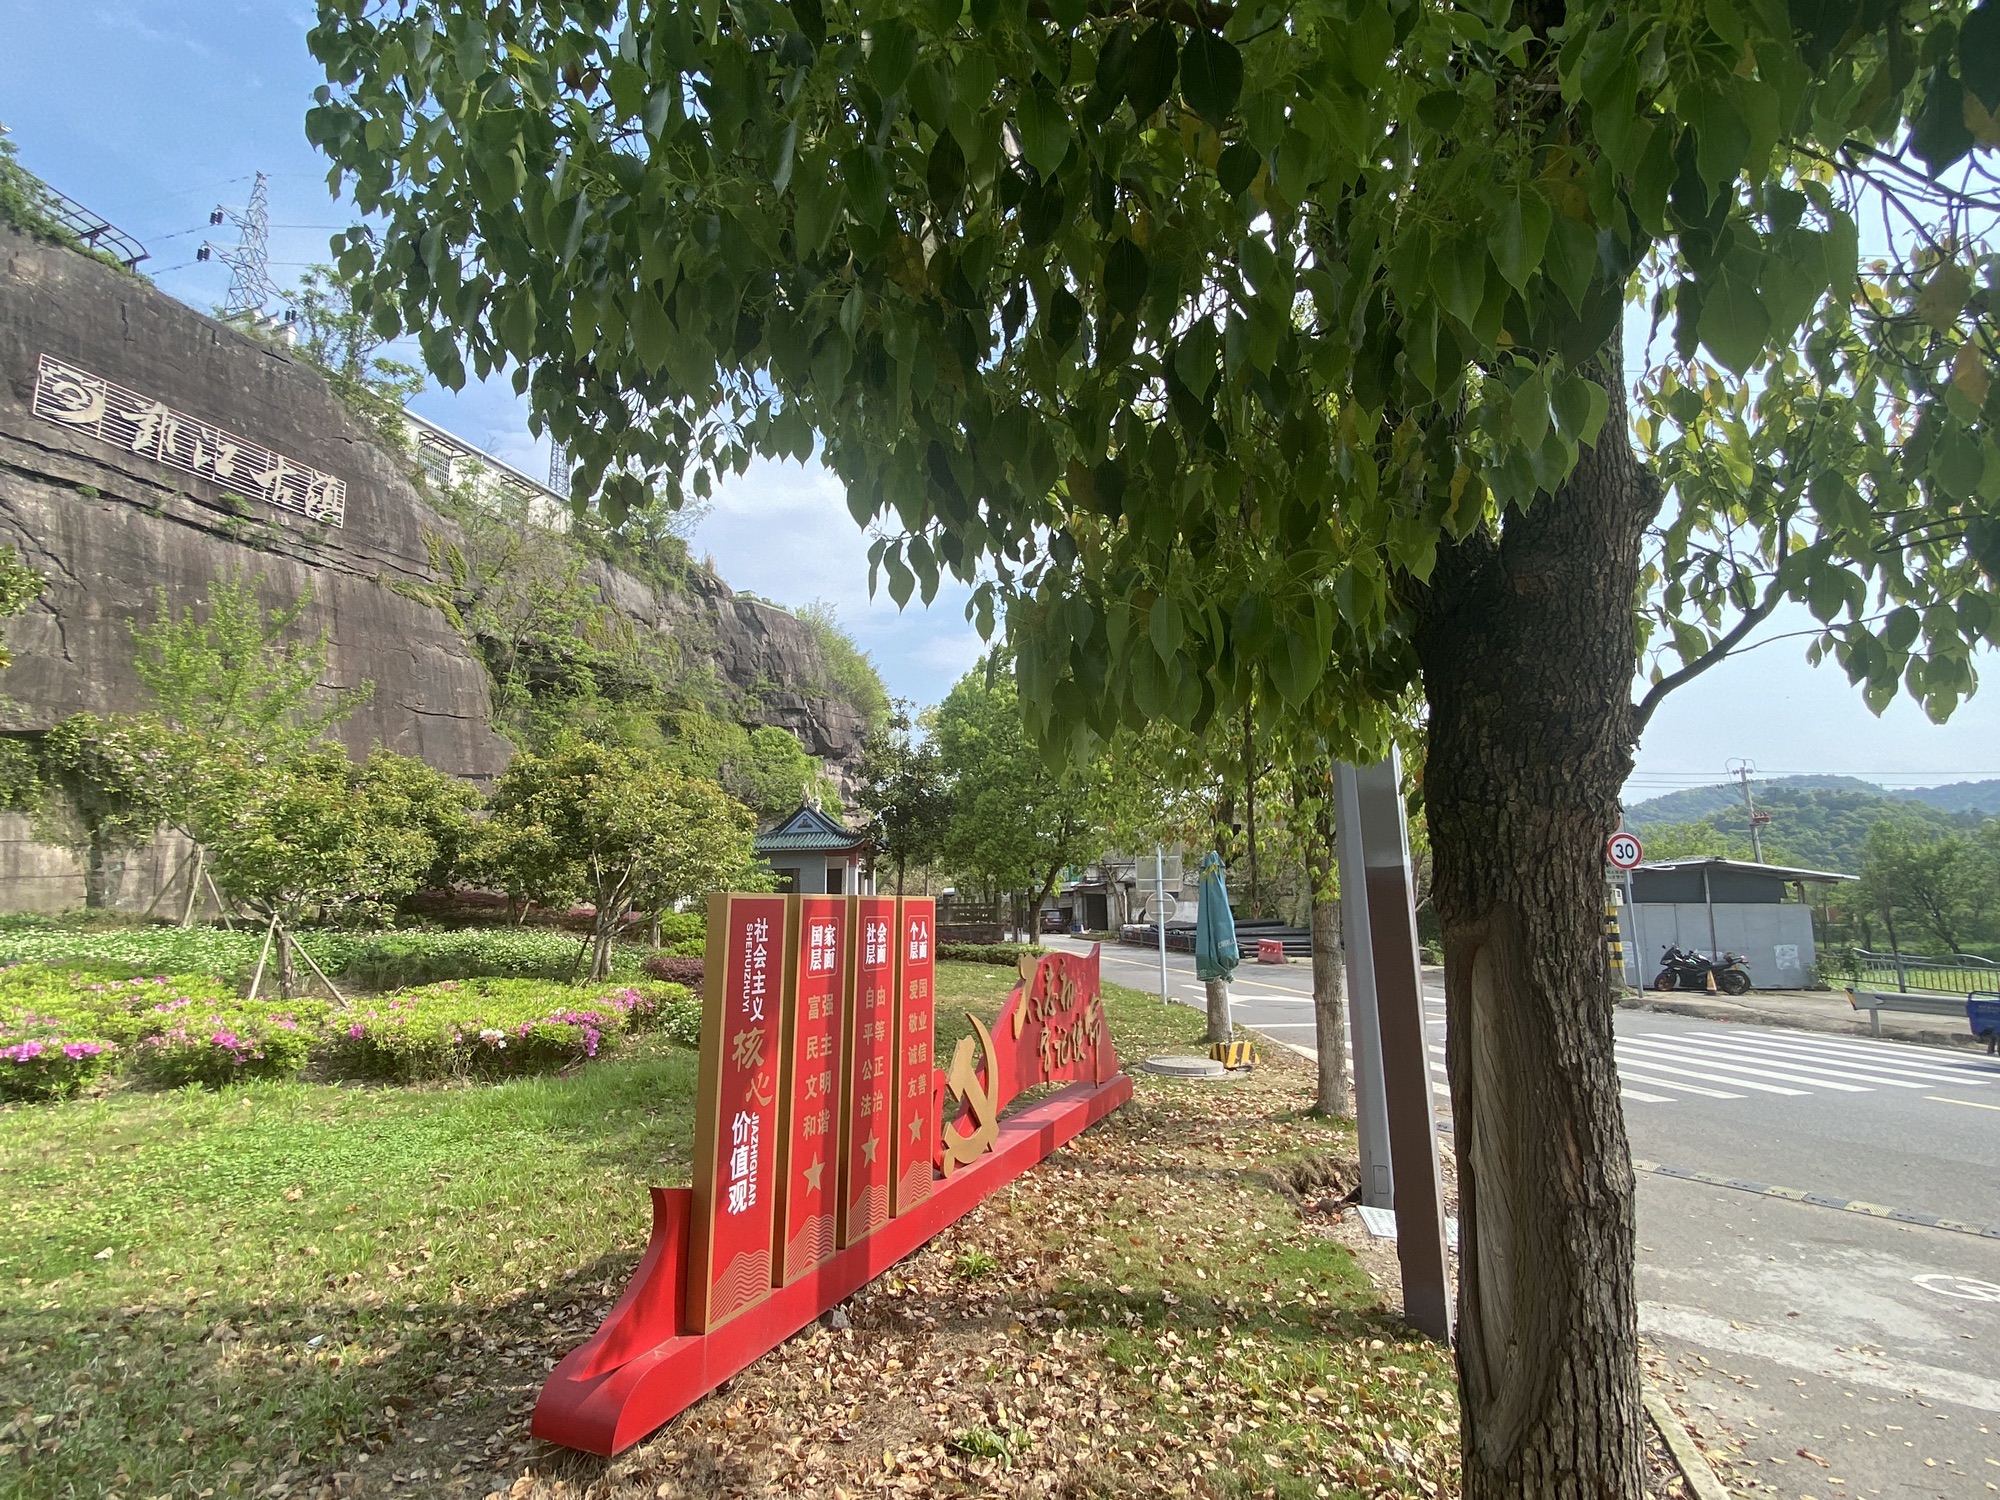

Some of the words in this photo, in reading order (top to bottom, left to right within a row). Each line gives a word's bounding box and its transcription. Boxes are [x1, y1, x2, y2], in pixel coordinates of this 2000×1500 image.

[1615, 843, 1635, 859] 30
[811, 924, 836, 947] 国家
[866, 922, 888, 944] 社会
[909, 921, 928, 941] 个人
[809, 948, 836, 971] 层面
[865, 944, 887, 966] 层面
[909, 940, 928, 960] 层面
[742, 923, 753, 1013] SHEHUIZHUYI
[750, 917, 769, 1022] 社会主义
[865, 985, 886, 1010] 自由
[909, 977, 928, 1000] 爱国
[807, 993, 834, 1021] 富强
[863, 1020, 885, 1046] 平等
[908, 1011, 928, 1033] 敬业
[805, 1033, 833, 1062] 民主
[907, 1043, 928, 1066] 诚信
[732, 1027, 774, 1107] 核心
[862, 1054, 884, 1081] 公正
[804, 1070, 832, 1101] 文明
[907, 1073, 927, 1099] 友善
[860, 1090, 883, 1118] 法治
[802, 1109, 830, 1140] 和谐
[727, 1110, 751, 1216] 价值观
[748, 1111, 760, 1207] JIAZHIGUAN
